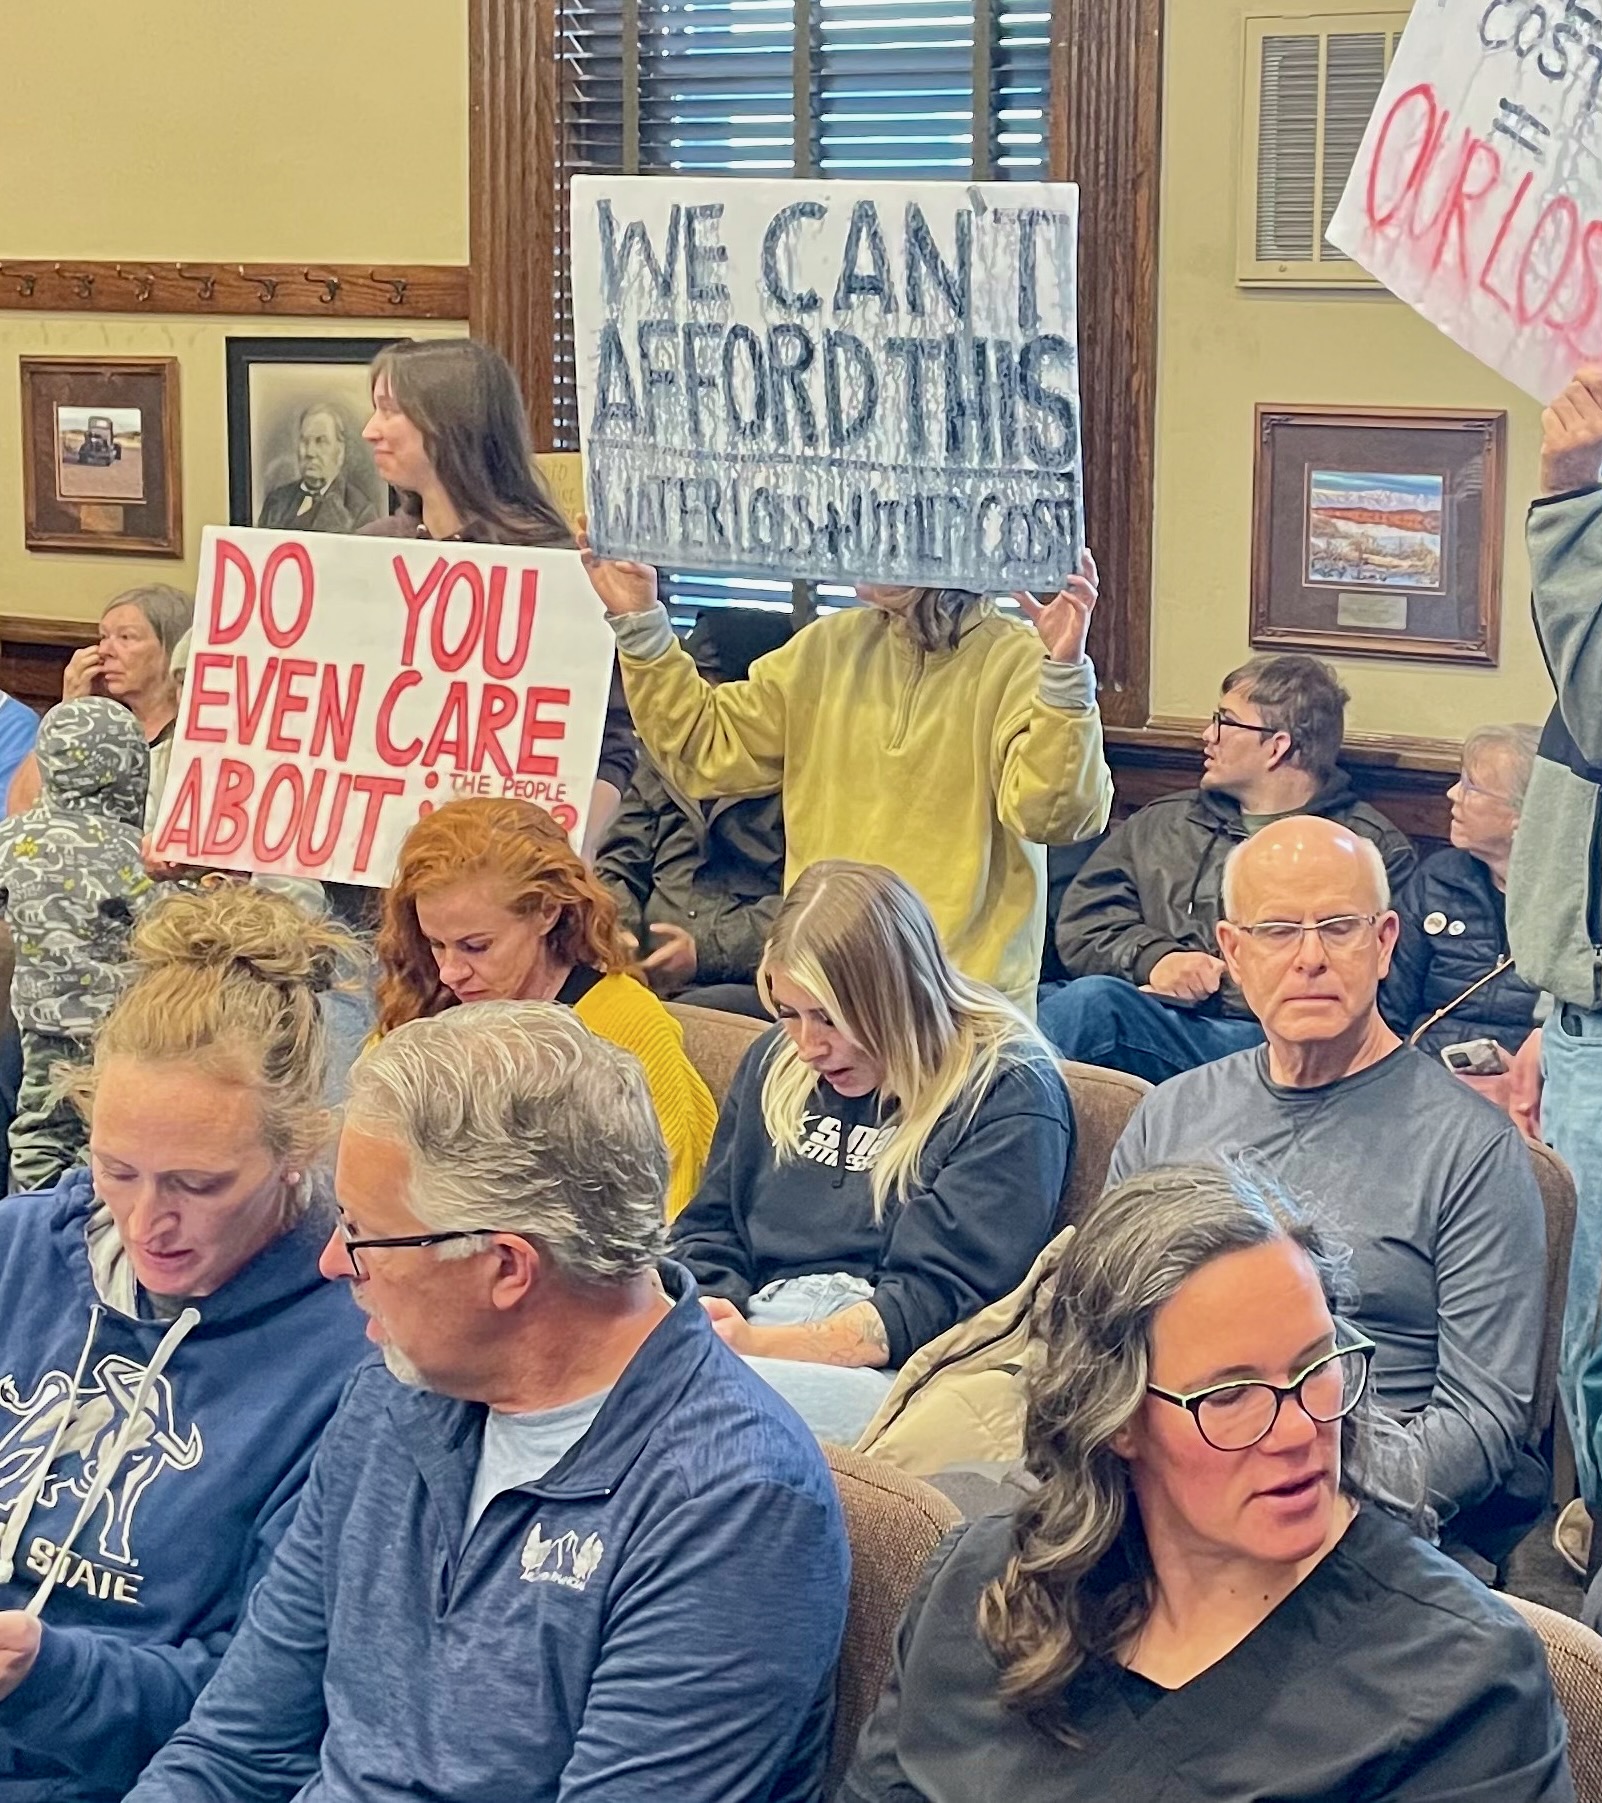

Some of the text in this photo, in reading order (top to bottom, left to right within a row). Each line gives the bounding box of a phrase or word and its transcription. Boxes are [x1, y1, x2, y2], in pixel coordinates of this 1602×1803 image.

[1364, 83, 1502, 280] OUR
[597, 185, 1071, 331] WE CAN'T
[592, 317, 1076, 468] AFFORD THIS
[208, 538, 539, 680] DO YOU
[185, 652, 570, 778] EVEN CARE
[156, 756, 405, 873] ABOUT
[450, 772, 567, 803] THE PEOPLE
[26, 1536, 144, 1607] STATE
